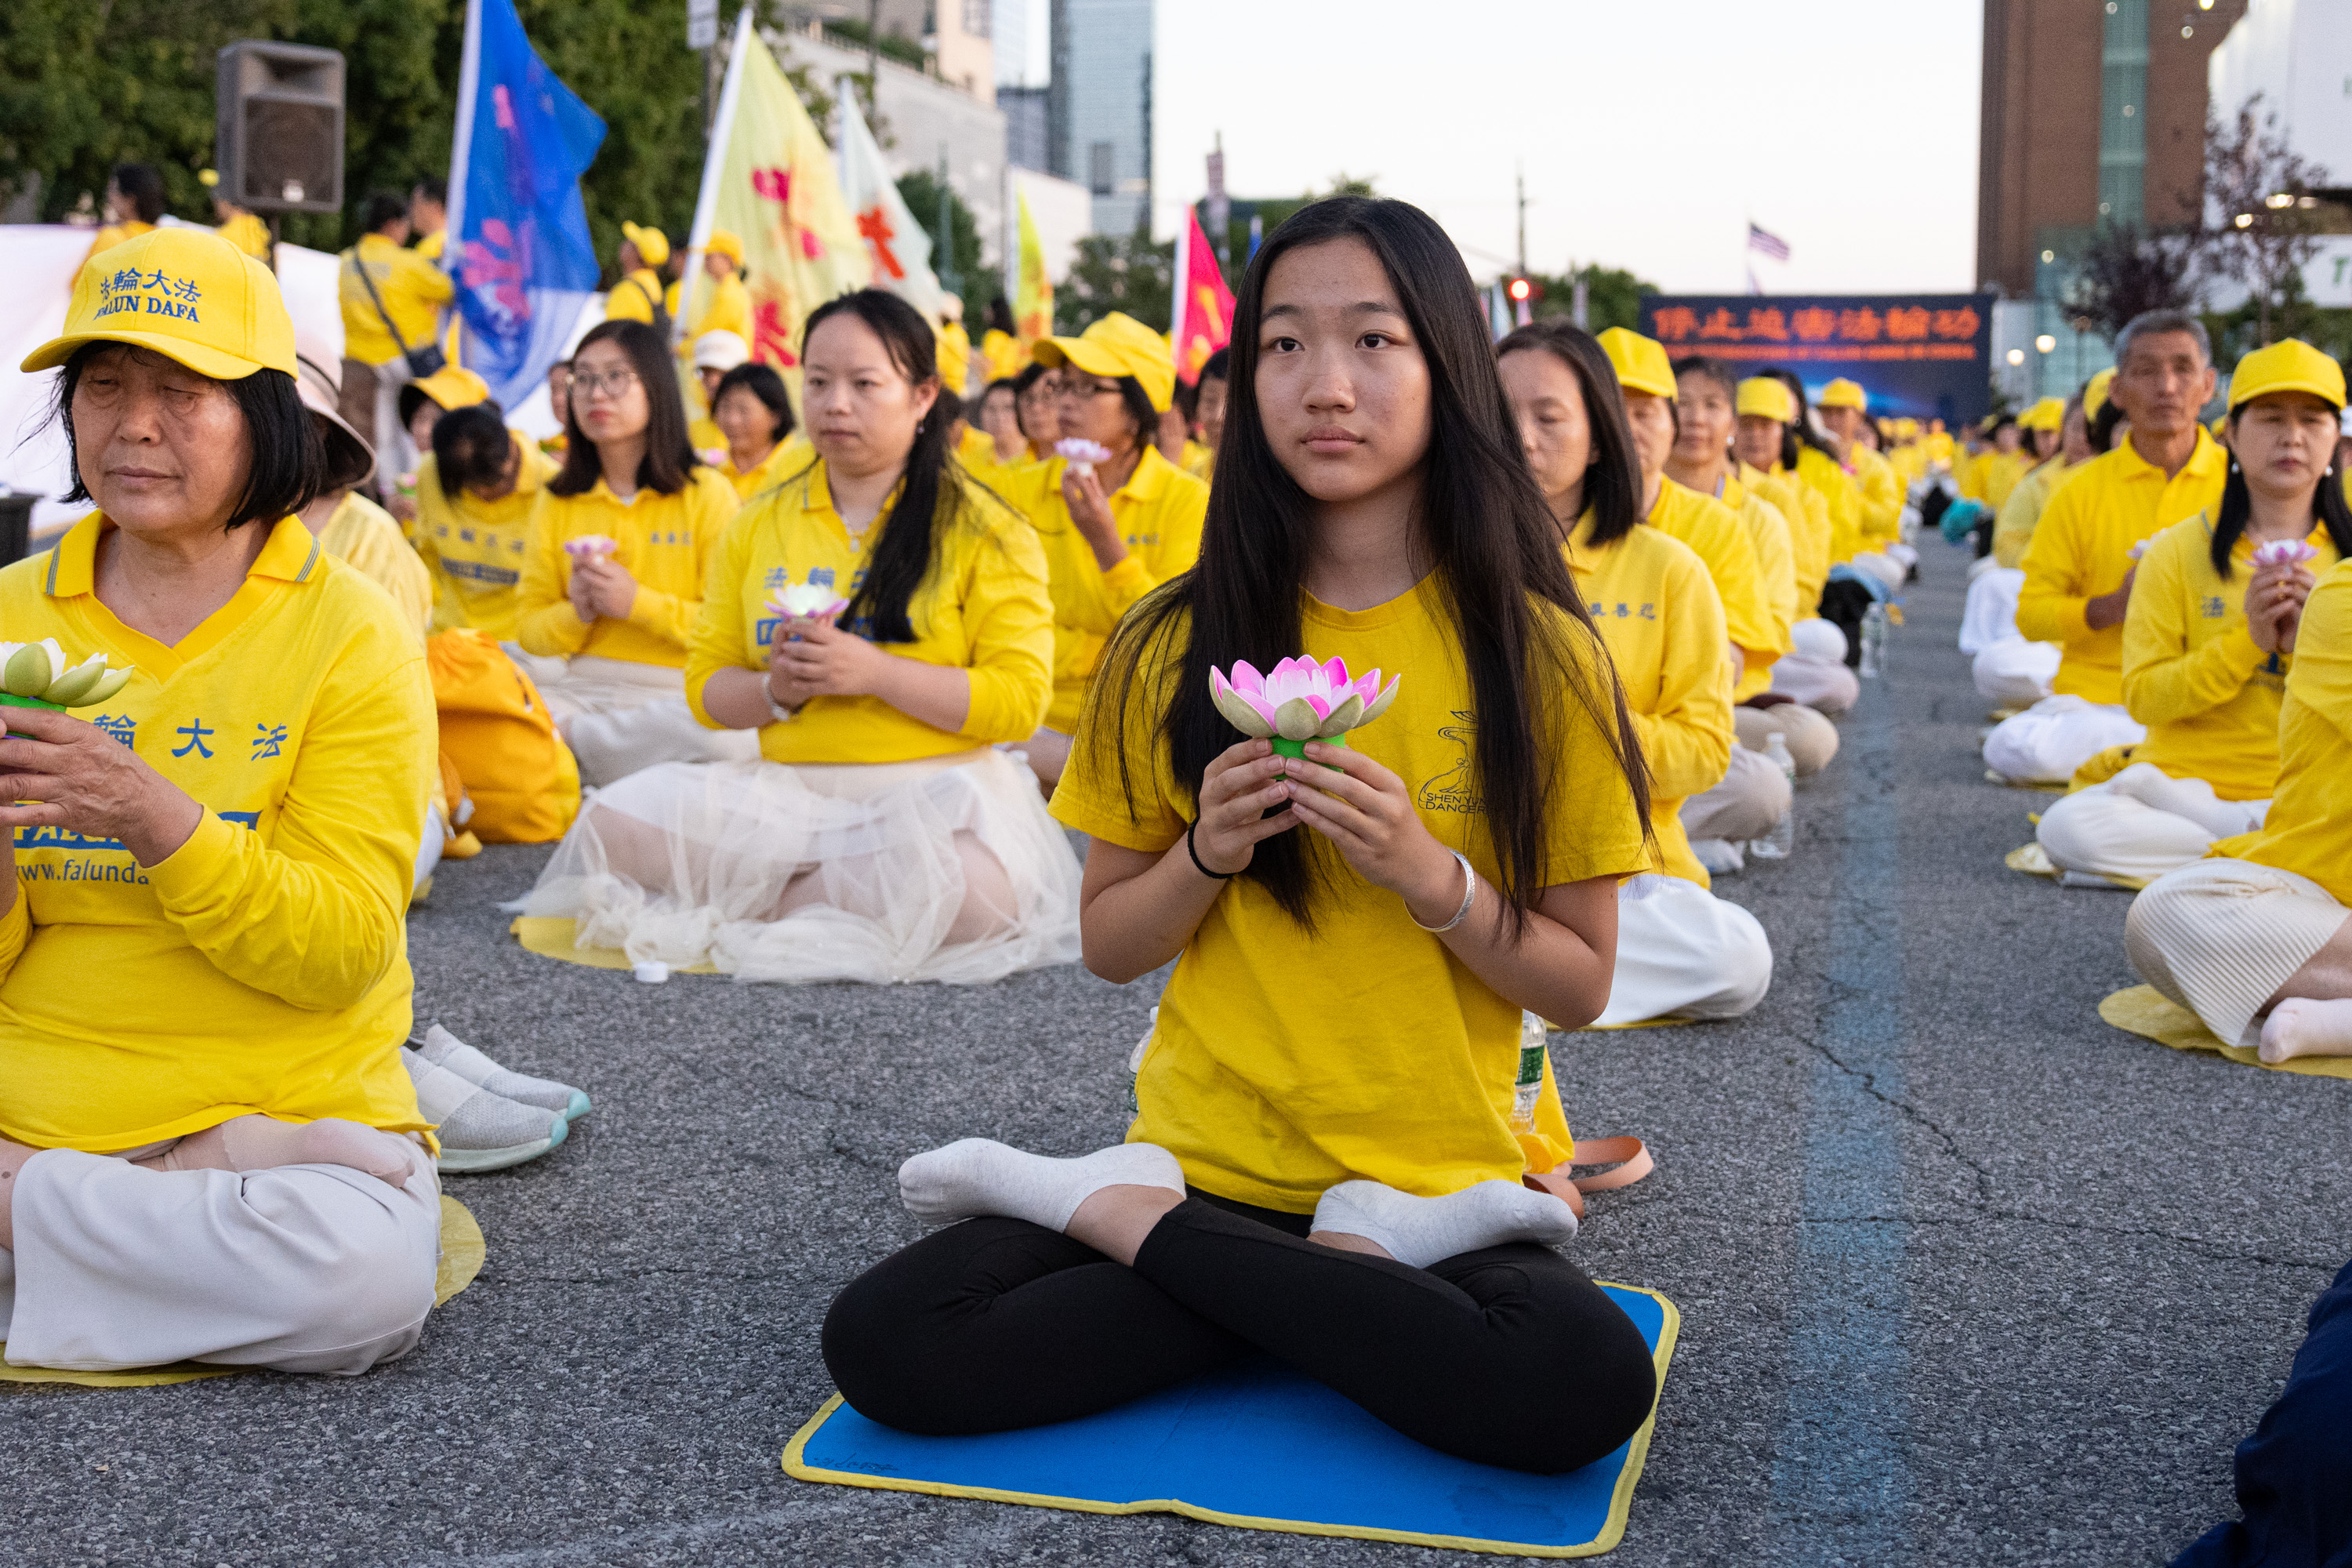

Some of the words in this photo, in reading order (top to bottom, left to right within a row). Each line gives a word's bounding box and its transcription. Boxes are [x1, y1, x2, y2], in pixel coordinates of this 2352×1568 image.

[93, 296, 140, 321] FALUN
[146, 296, 200, 323] DAFA
[1426, 793, 1461, 804] SHEN
